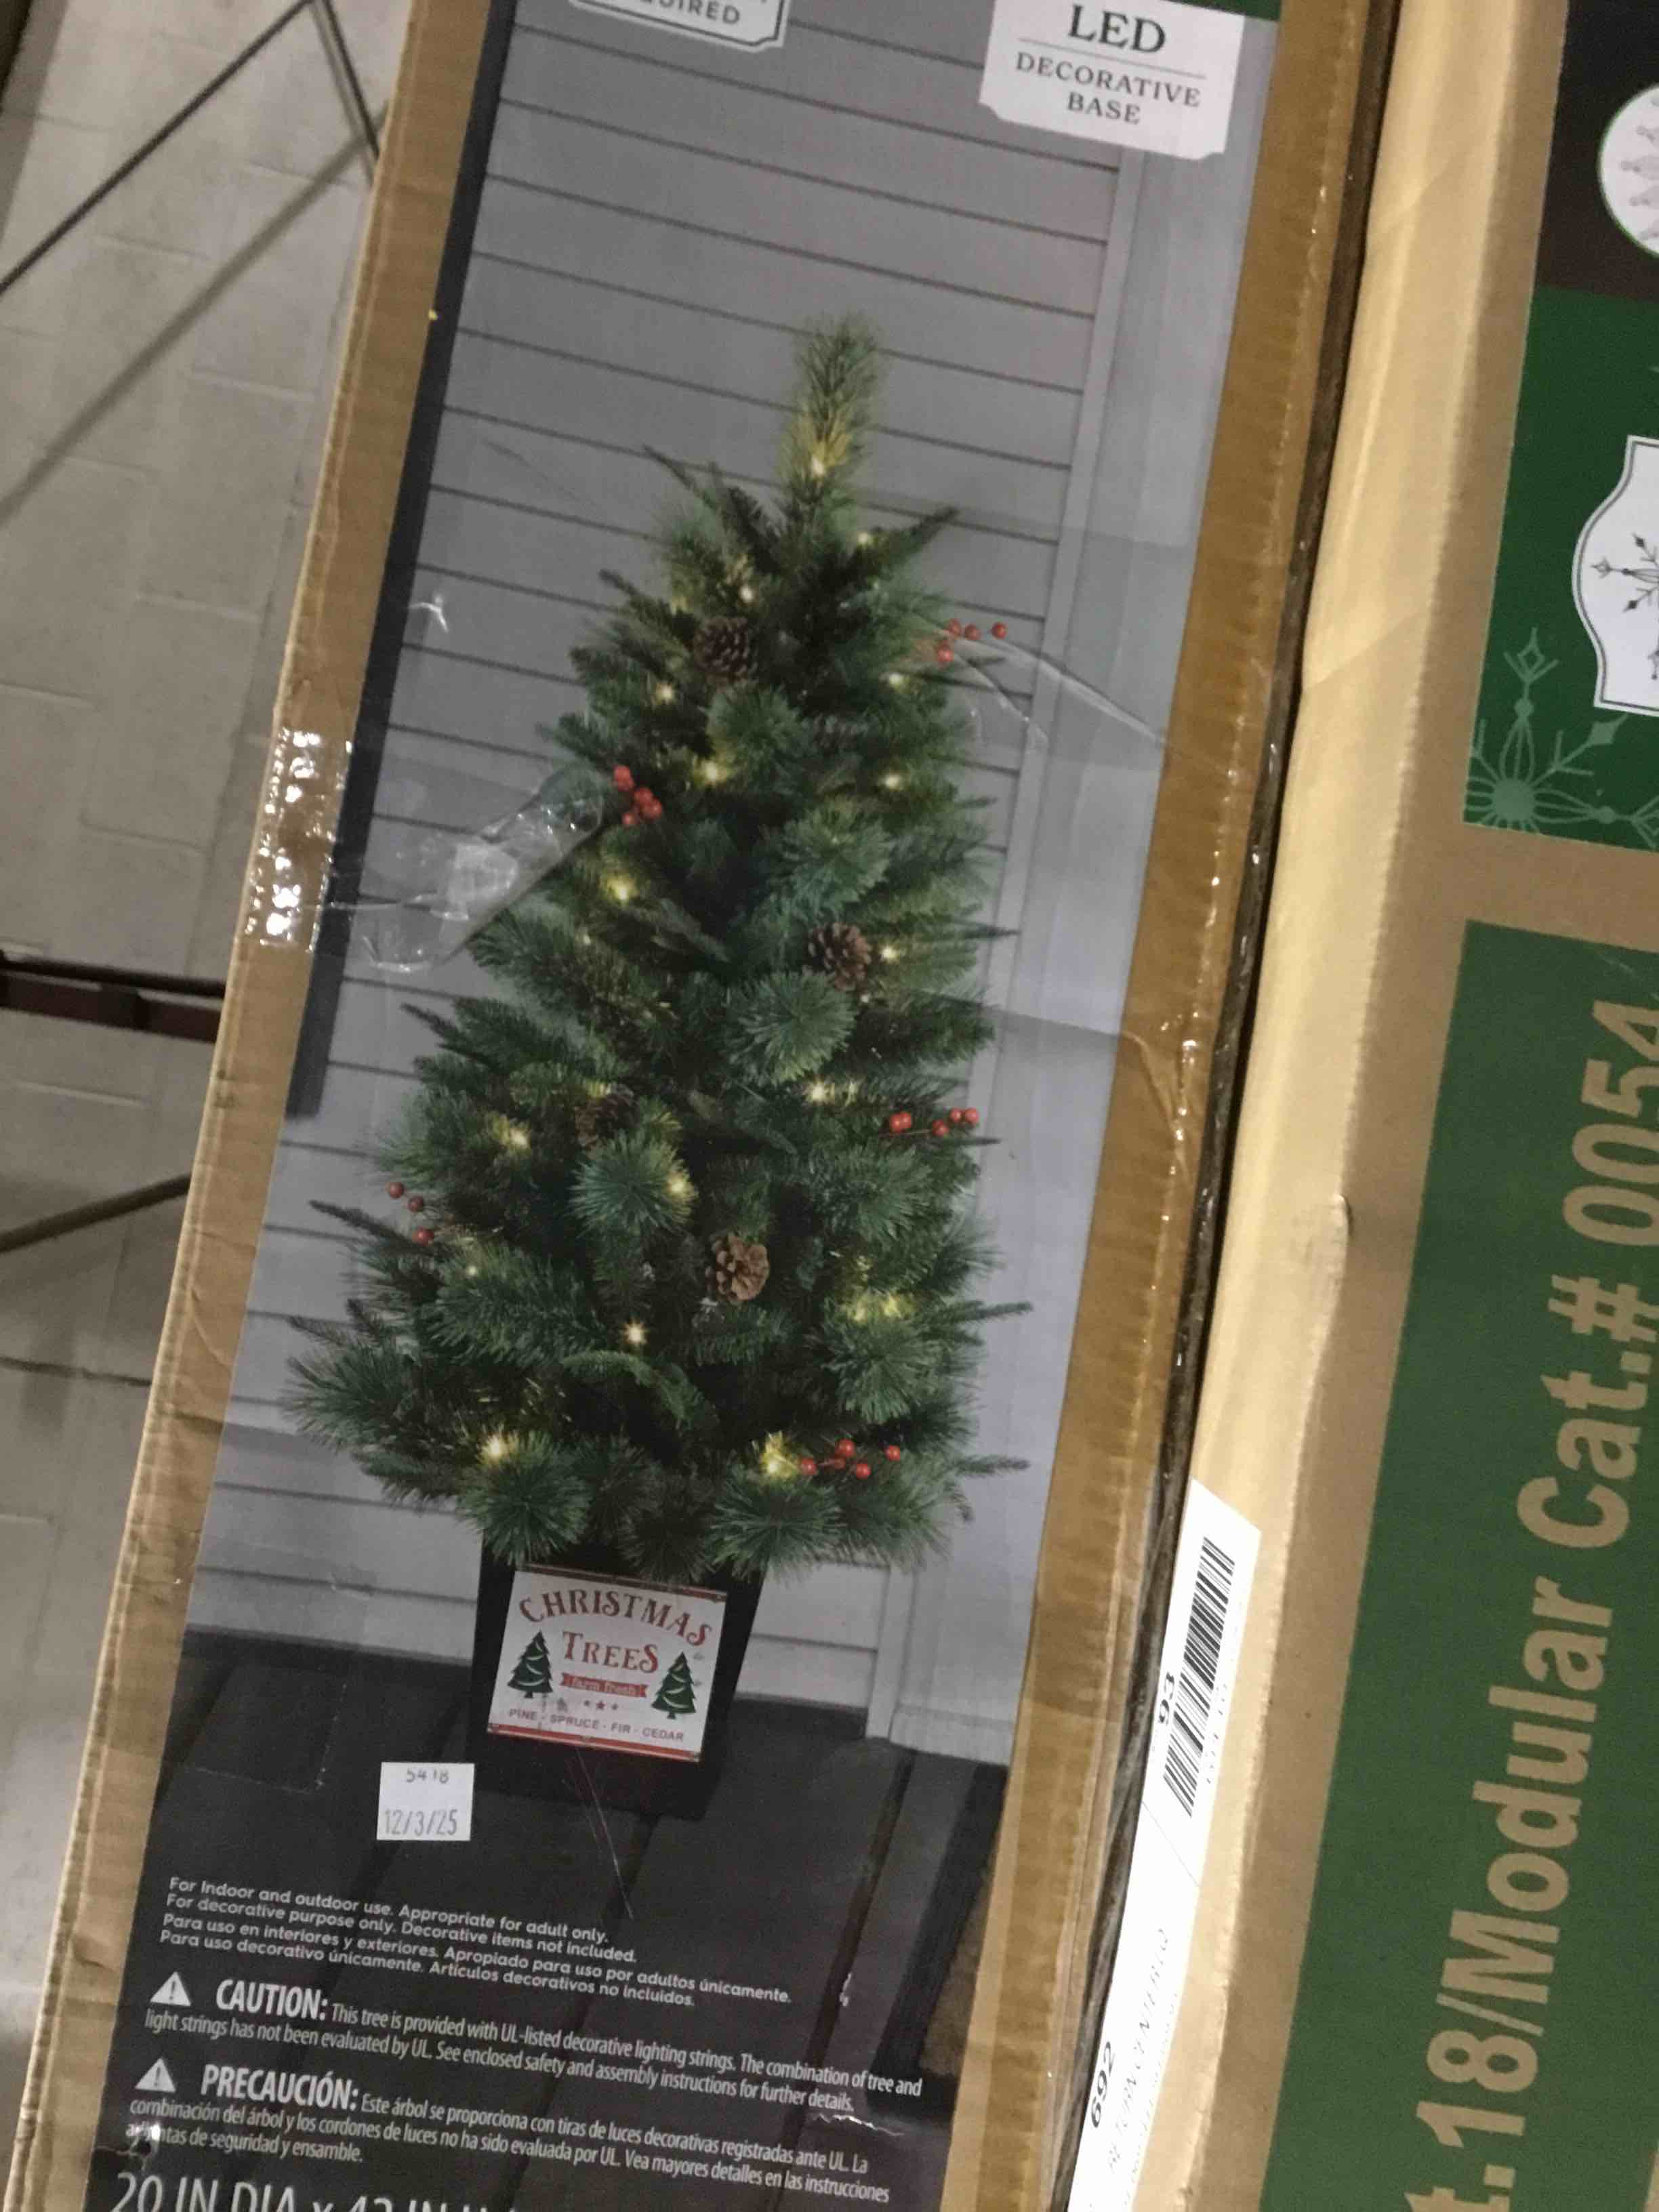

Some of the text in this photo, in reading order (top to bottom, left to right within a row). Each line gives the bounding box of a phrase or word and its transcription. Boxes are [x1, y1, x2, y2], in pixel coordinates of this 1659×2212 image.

[1068, 4, 1166, 54] LED
[1016, 52, 1201, 108] DECORATIVE
[1067, 91, 1141, 125] BASE
[1516, 1274, 1659, 1549] Cat.#
[519, 1589, 713, 1647] CHRISTMAS
[562, 1630, 659, 1674] TREES
[509, 1708, 684, 1742] PINE SPRUCE FIR CEDAR
[166, 1892, 637, 1963] For decorative purpose only. Decorative items not included.
[169, 1877, 197, 1891] For
[258, 1890, 291, 1904] and
[295, 1893, 359, 1911] outdoor
[363, 1902, 394, 1916] use.
[398, 1904, 495, 1928] Appropriate
[499, 1916, 523, 1931] for
[526, 1922, 568, 1938] adult
[571, 1927, 608, 1945] only.
[160, 1929, 200, 1947] Para
[204, 1938, 232, 1950] uso
[237, 1939, 325, 1961] decorativo
[503, 1970, 595, 1994] decorativos
[599, 1984, 619, 1996] no
[163, 1913, 203, 1931] Para
[206, 1921, 236, 1933] uso
[239, 1924, 260, 1936] en
[264, 1924, 340, 1946] interiores
[343, 1937, 353, 1950] y
[356, 1938, 438, 1958] exteriores.
[443, 1946, 529, 1969] Apropiado
[532, 1960, 571, 1974] para
[575, 1965, 602, 1978] uso
[605, 1969, 634, 1982] por
[636, 1972, 695, 1990] adultos
[144, 2008, 179, 2032] light
[180, 2015, 228, 2039] strings
[229, 2018, 255, 2039] has
[257, 2025, 282, 2042] not
[283, 2023, 319, 2046] been
[321, 2030, 390, 2053] evaluated
[391, 2035, 410, 2060] by
[435, 2041, 462, 2062] See
[463, 2047, 524, 2069] enclosed
[524, 2052, 566, 2078] safety
[567, 2059, 595, 2078] and
[595, 2064, 659, 2090] assembly
[660, 2069, 737, 2096] instructions
[739, 2078, 760, 2099] for
[760, 2081, 807, 2105] further
[808, 2088, 855, 2112] details.
[216, 1978, 329, 2022] CAUTION:
[331, 2003, 359, 2024] This
[361, 2009, 389, 2028] tree
[390, 2011, 402, 2030] is
[403, 2015, 466, 2036] provided
[467, 2021, 498, 2041] with
[562, 2031, 633, 2057] decorative
[634, 2040, 687, 2068] lighting
[688, 2049, 736, 2074] strings.
[741, 2053, 765, 2075] The
[766, 2061, 850, 2087] combination
[851, 2070, 868, 2088] of
[867, 2074, 895, 2093] tree
[895, 2078, 923, 2097] and
[129, 2097, 220, 2121] combinación
[222, 2104, 246, 2124] del
[246, 2107, 285, 2129] árbol
[284, 2115, 295, 2135] y
[296, 2111, 316, 2132] los
[318, 2116, 381, 2139] cordones
[382, 2121, 402, 2142] de
[403, 2123, 438, 2145] luces
[439, 2131, 459, 2148] no
[460, 2130, 478, 2150] ha
[480, 2133, 509, 2153] sido
[510, 2138, 573, 2160] evaluada
[573, 2148, 599, 2166] por
[625, 2148, 650, 2170] Vea
[651, 2157, 709, 2177] mayores
[710, 2160, 762, 2186] detalles
[764, 2172, 783, 2188] en
[784, 2170, 803, 2190] las
[804, 2173, 890, 2203] instrucciones
[188, 2127, 209, 2147] de
[209, 2133, 280, 2153] seguridad
[279, 2140, 291, 2159] y
[292, 2141, 363, 2163] ensamble.
[201, 2064, 358, 2111] PRECAUCIÓN:
[361, 2093, 390, 2114] Este
[391, 2097, 428, 2118] árbol
[428, 2105, 445, 2121] se
[446, 2107, 528, 2130] proporciona
[530, 2117, 555, 2133] con
[558, 2117, 586, 2137] tiras
[588, 2119, 607, 2139] de
[607, 2121, 642, 2144] luces
[644, 2127, 720, 2154] decorativas
[720, 2140, 794, 2164] registradas
[795, 2151, 827, 2169] ante
[851, 2154, 868, 2175] La
